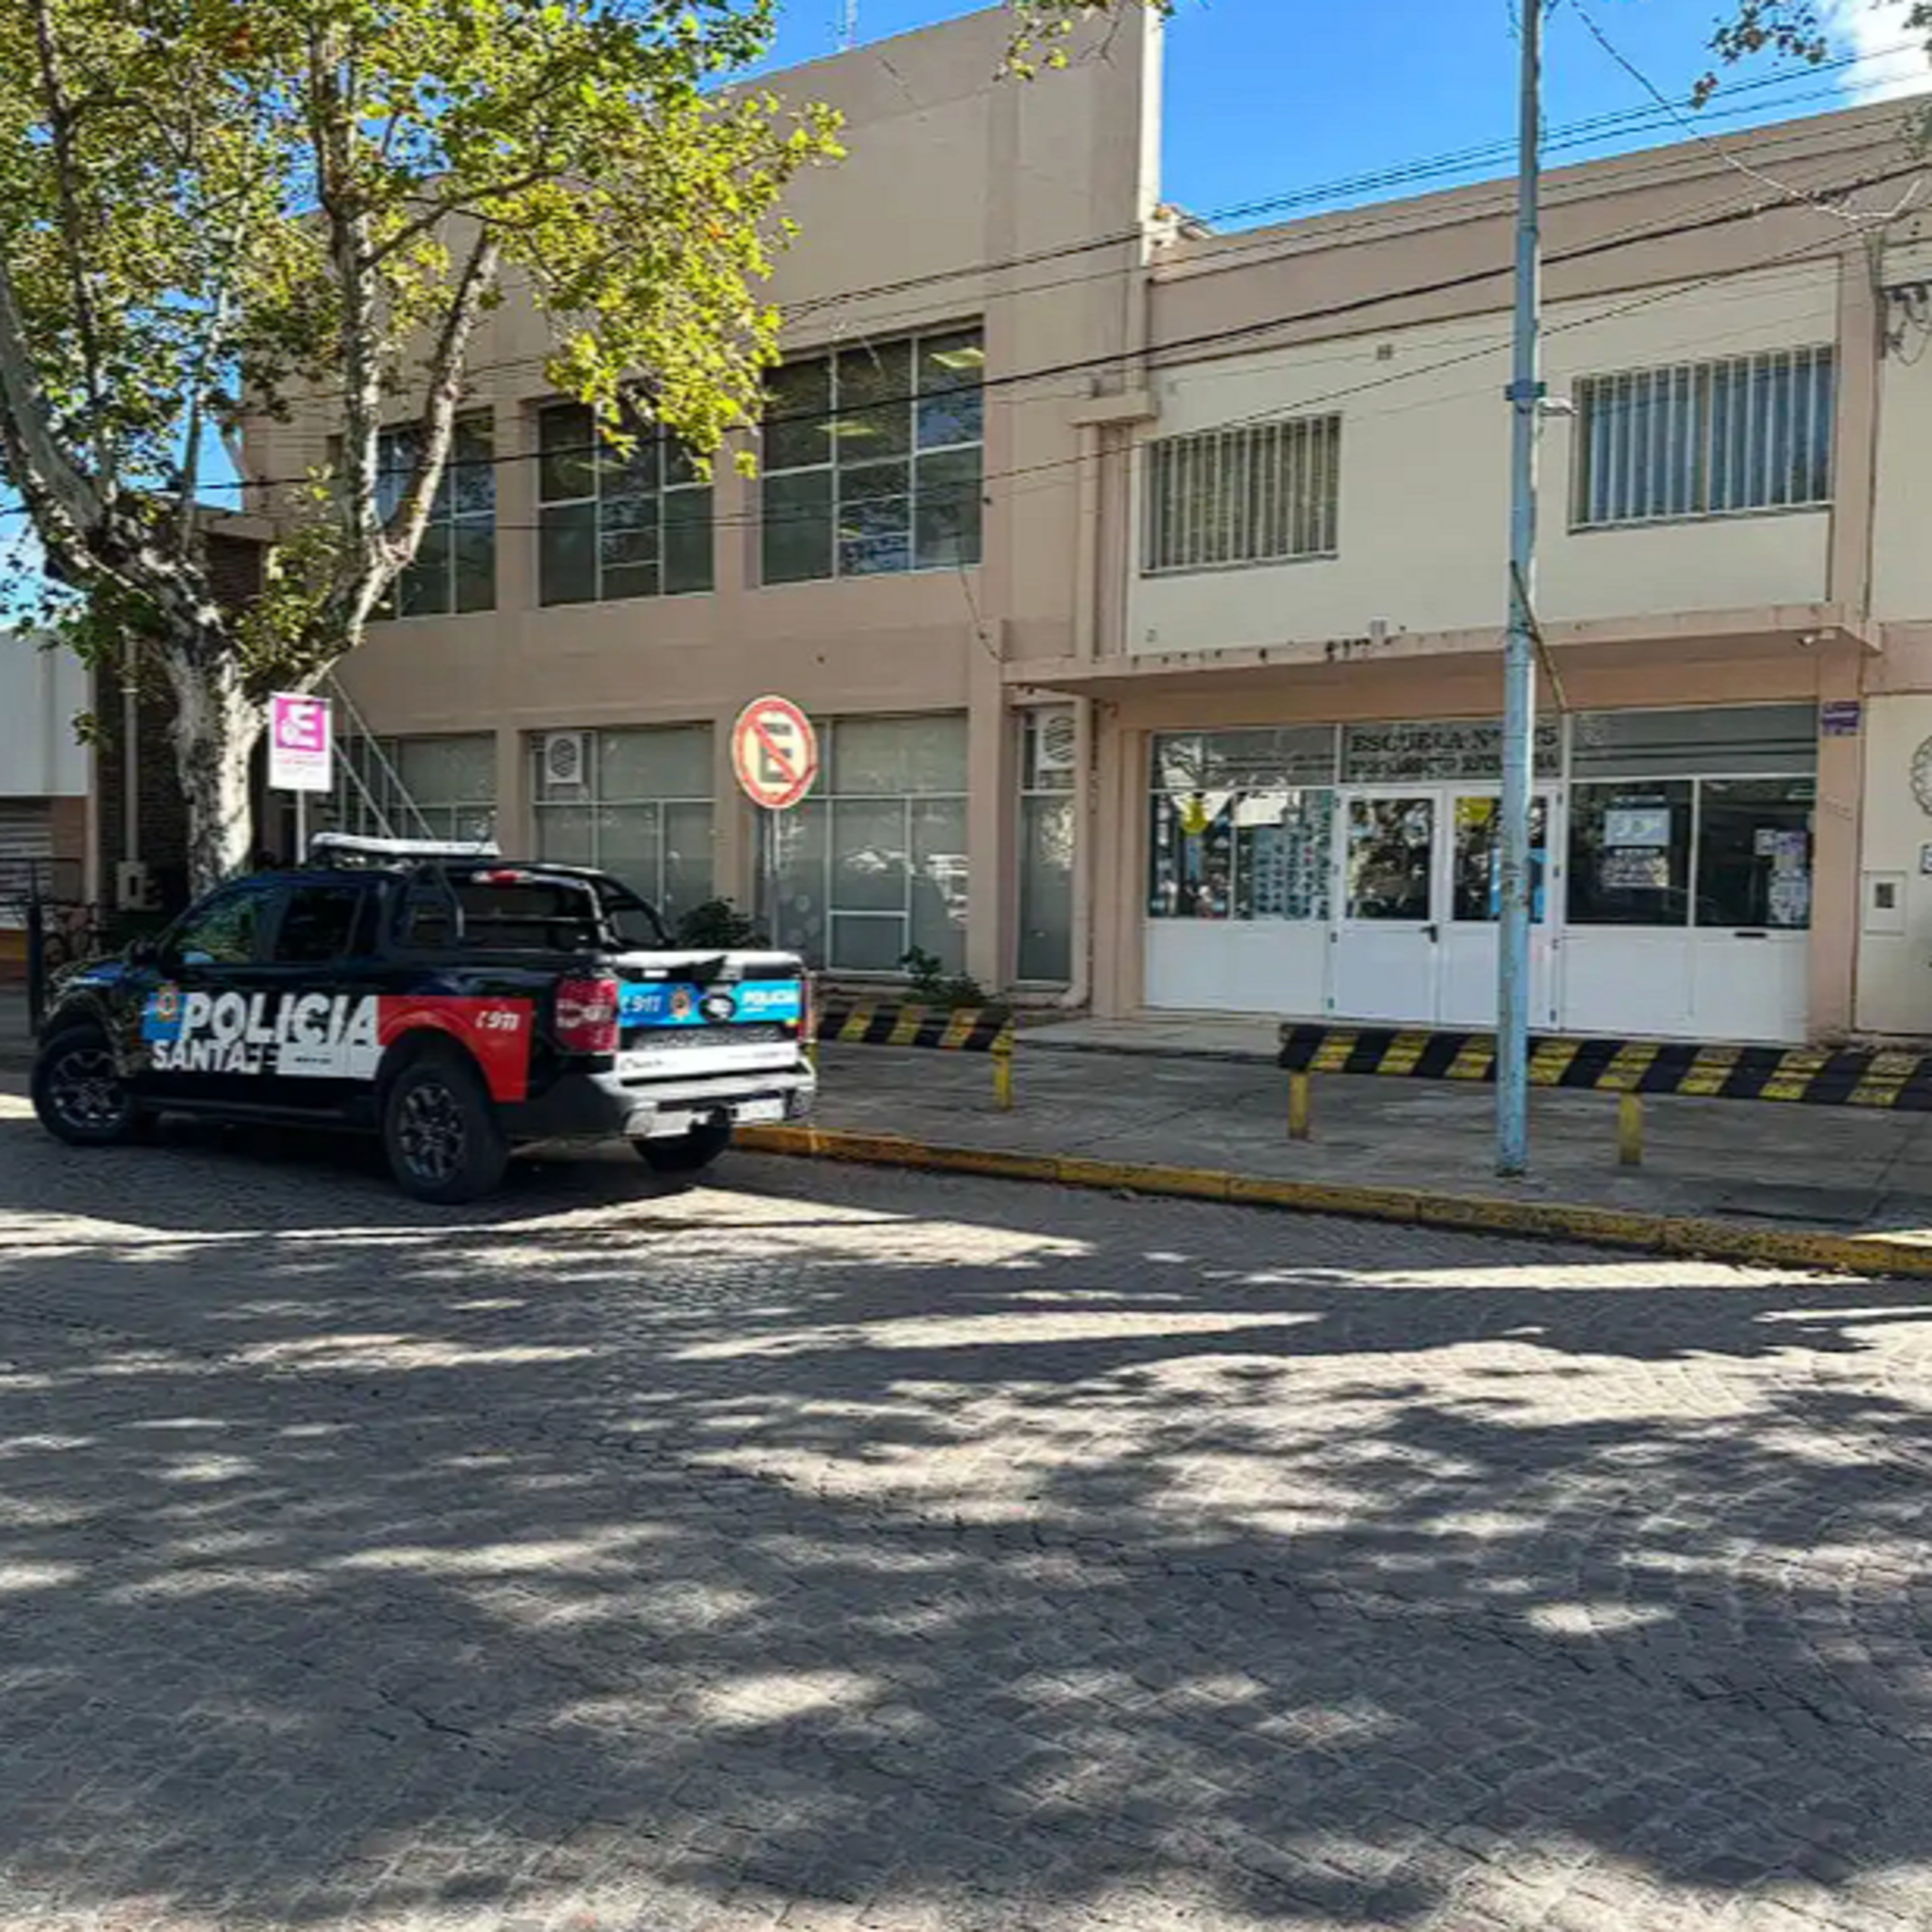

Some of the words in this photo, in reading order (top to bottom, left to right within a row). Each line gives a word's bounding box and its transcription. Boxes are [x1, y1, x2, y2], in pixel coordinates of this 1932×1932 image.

[759, 723, 793, 783] E
[1350, 731, 1465, 752] ESCUELA
[181, 992, 376, 1046] POLICIA
[151, 1039, 247, 1073] SANTA
